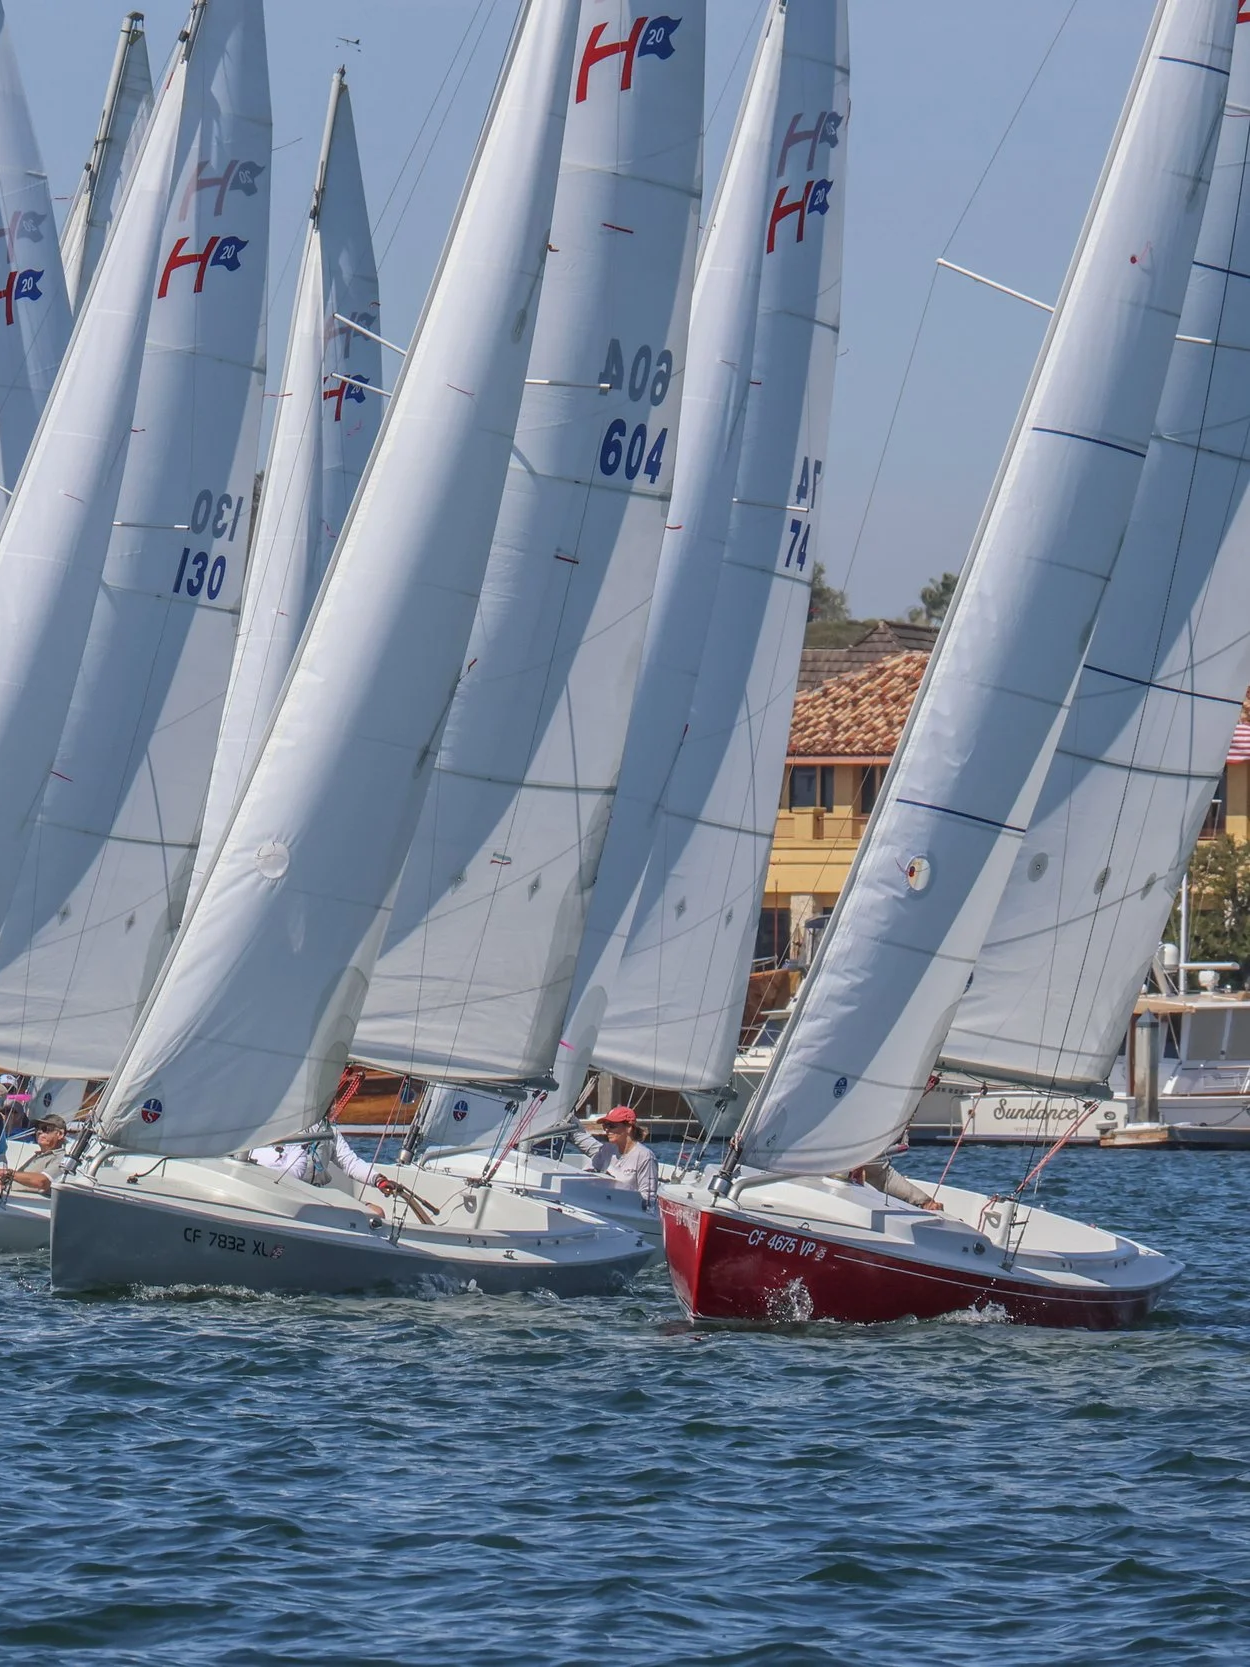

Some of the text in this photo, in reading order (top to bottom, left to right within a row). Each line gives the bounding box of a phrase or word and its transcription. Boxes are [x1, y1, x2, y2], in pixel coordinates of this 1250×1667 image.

[575, 16, 665, 104] H 20
[766, 180, 826, 254] H 20
[21, 276, 34, 293] 20
[157, 236, 237, 299] H 20
[600, 418, 669, 484] 604
[785, 518, 811, 572] 74
[173, 547, 227, 600] 130
[993, 1098, 1079, 1120] Sundance
[183, 1227, 202, 1243] CF
[209, 1231, 246, 1253] 7832
[252, 1239, 269, 1257] XL
[748, 1229, 768, 1247] CF
[767, 1233, 799, 1254] 4675
[799, 1240, 816, 1257] VP
